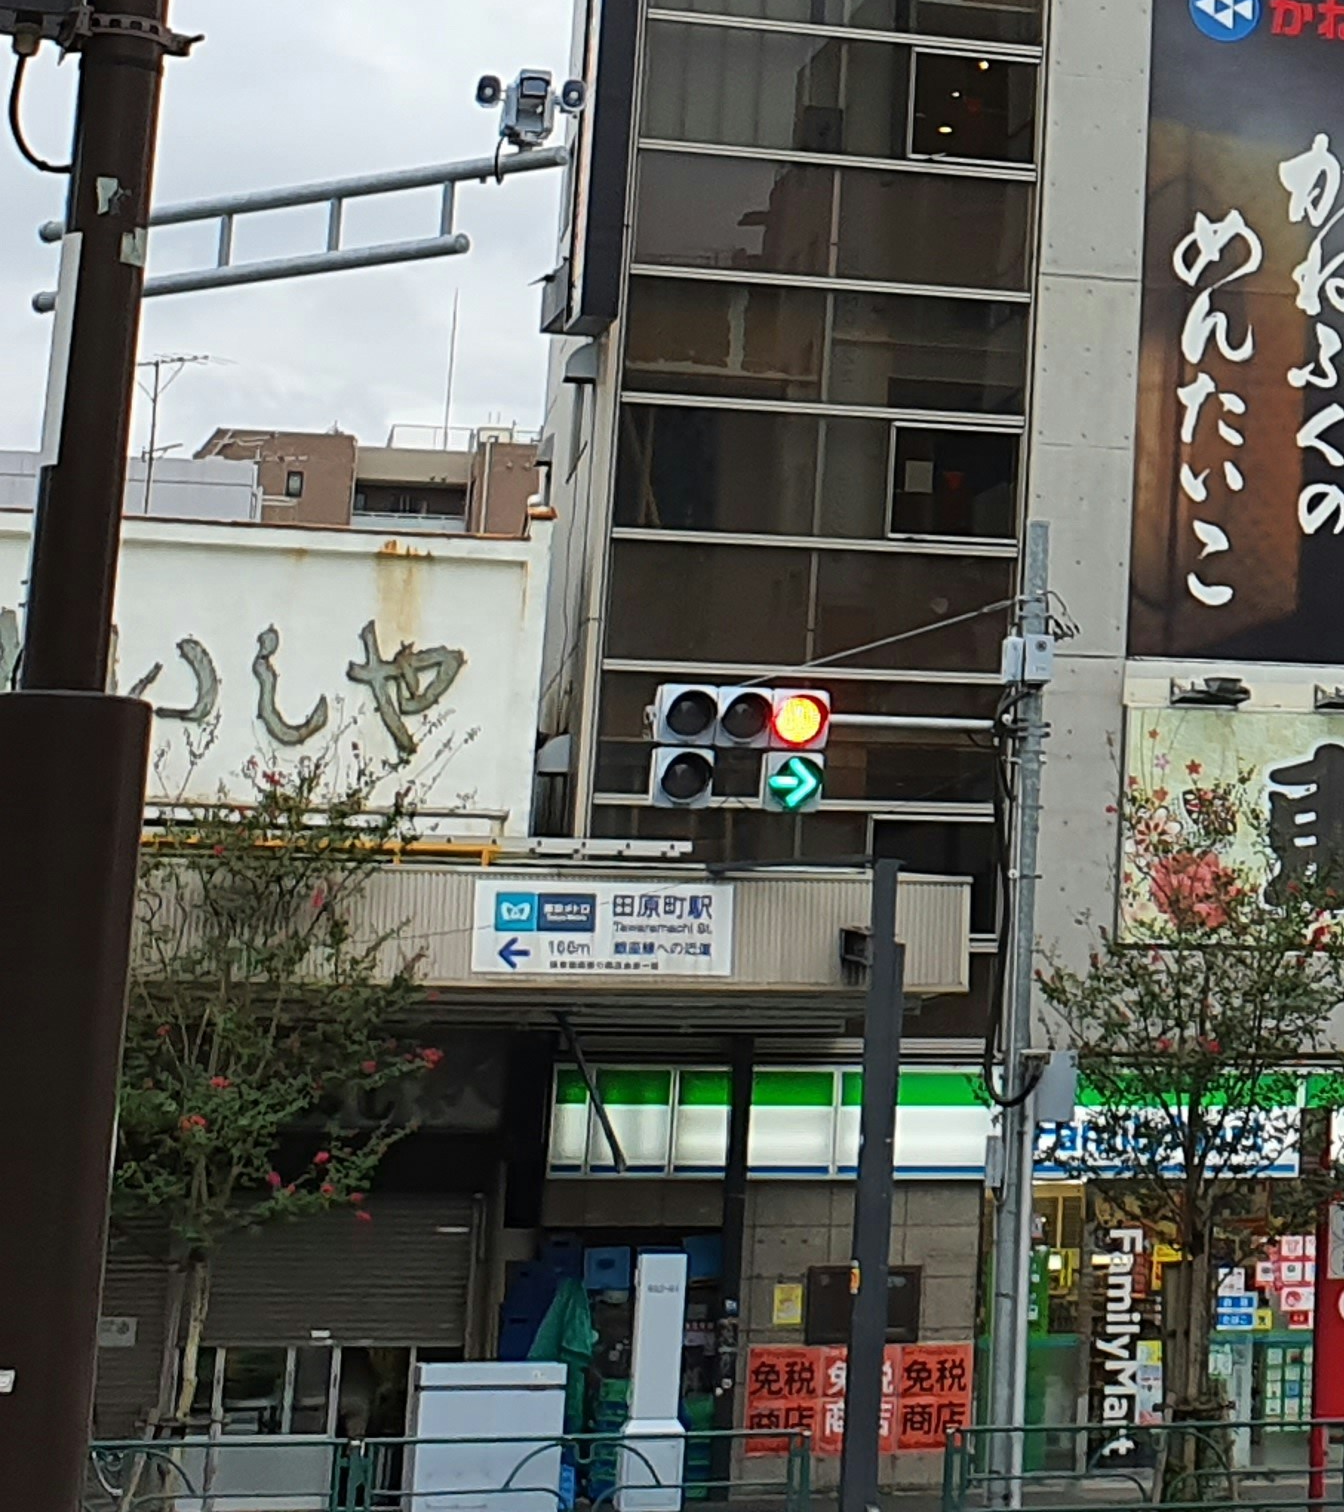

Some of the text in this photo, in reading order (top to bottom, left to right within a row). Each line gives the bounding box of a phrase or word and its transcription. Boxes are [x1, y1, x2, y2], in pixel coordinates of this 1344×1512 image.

[1171, 209, 1265, 608] めんたいこ
[612, 894, 712, 920] 田原町駅
[751, 1360, 815, 1395] 免税
[904, 1358, 967, 1394] 免税
[903, 1401, 966, 1435] 商店
